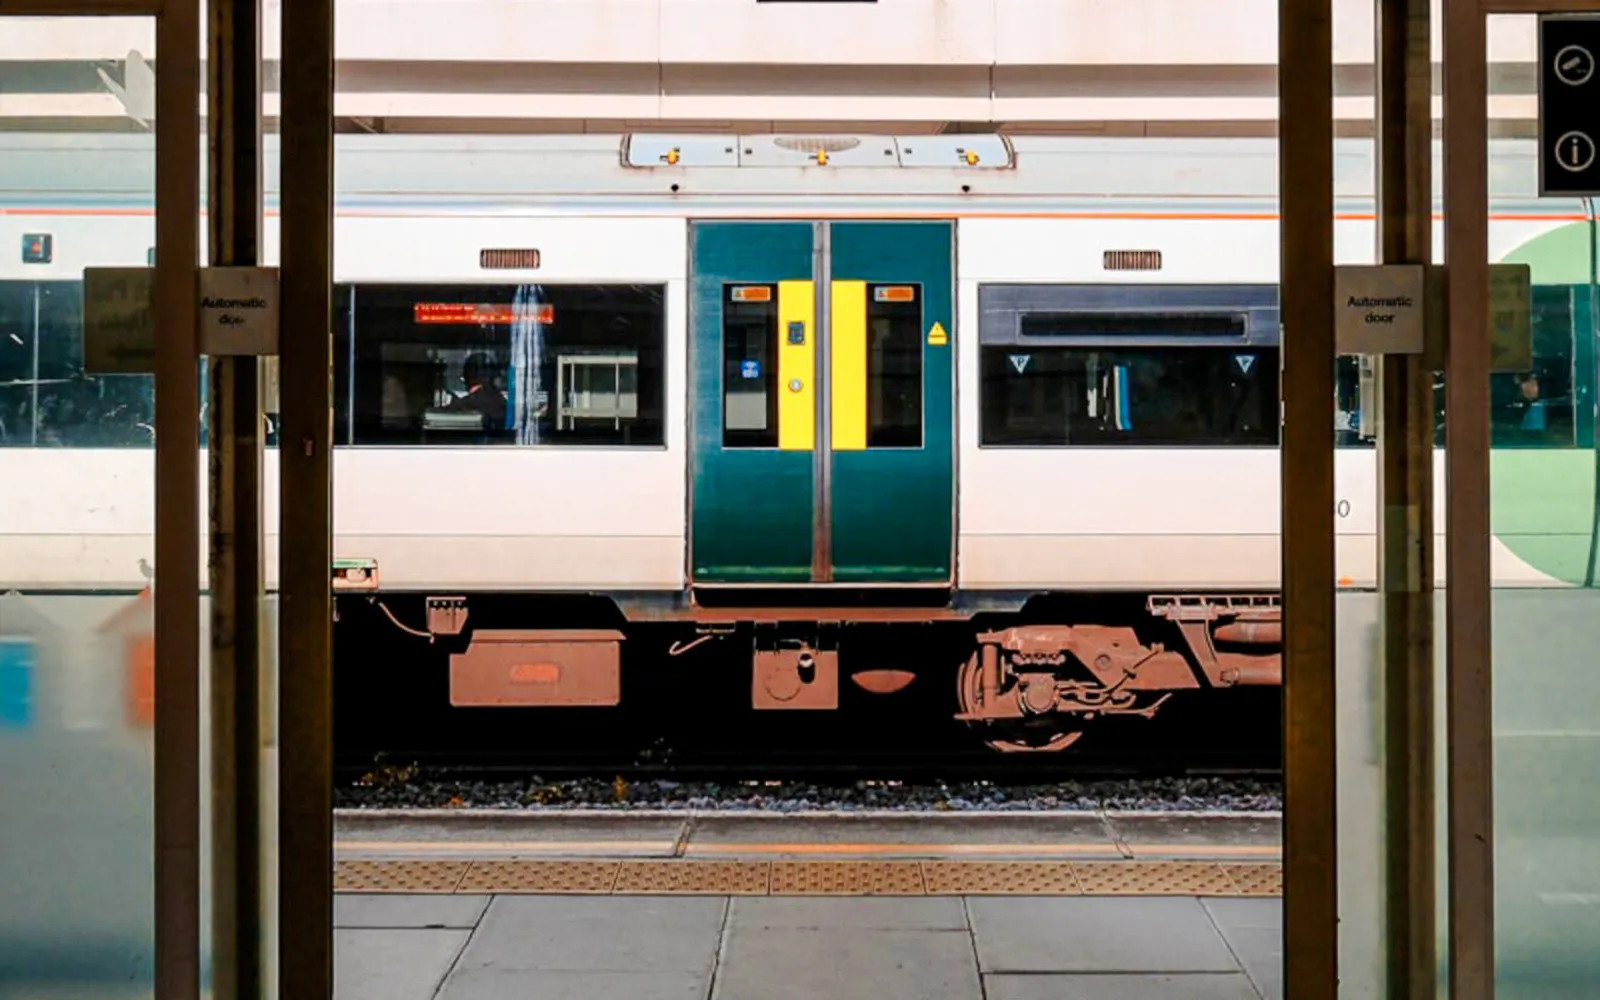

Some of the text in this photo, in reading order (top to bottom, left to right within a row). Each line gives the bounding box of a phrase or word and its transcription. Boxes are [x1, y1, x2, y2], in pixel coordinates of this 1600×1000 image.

[201, 297, 266, 308] Automatic
[1347, 296, 1412, 307] Automatic
[1365, 312, 1395, 324] door
